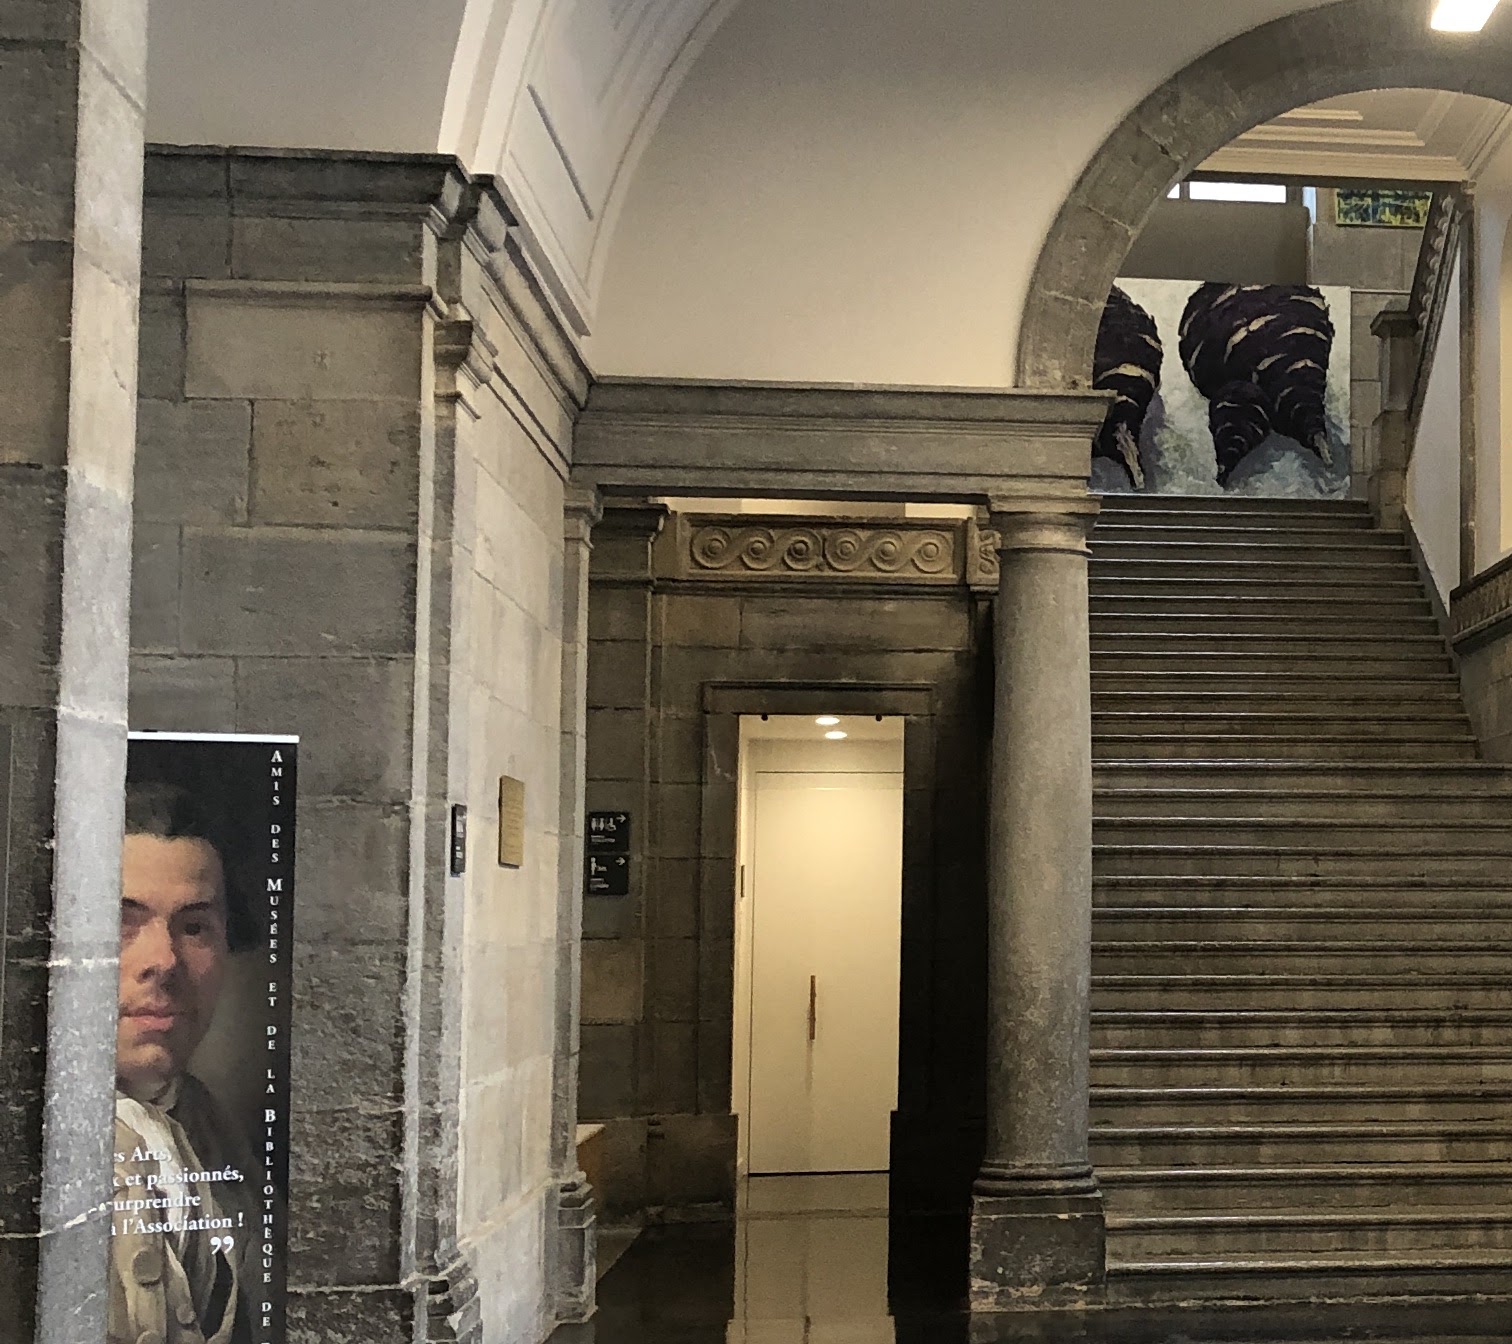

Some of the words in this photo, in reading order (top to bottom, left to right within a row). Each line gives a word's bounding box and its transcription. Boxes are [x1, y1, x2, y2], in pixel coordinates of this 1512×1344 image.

[271, 750, 283, 805] AMIS
[270, 824, 281, 862] DES
[267, 878, 283, 964] MUSÉES
[268, 982, 277, 1006] ET
[267, 1025, 277, 1050] DE
[266, 1069, 275, 1093] LA
[125, 1175, 144, 1186] et
[147, 1165, 244, 1191] passionnés,
[113, 1192, 201, 1216] urprendre
[262, 1109, 276, 1283] BIBLIOTHÈQUE
[261, 1302, 271, 1327] DE
